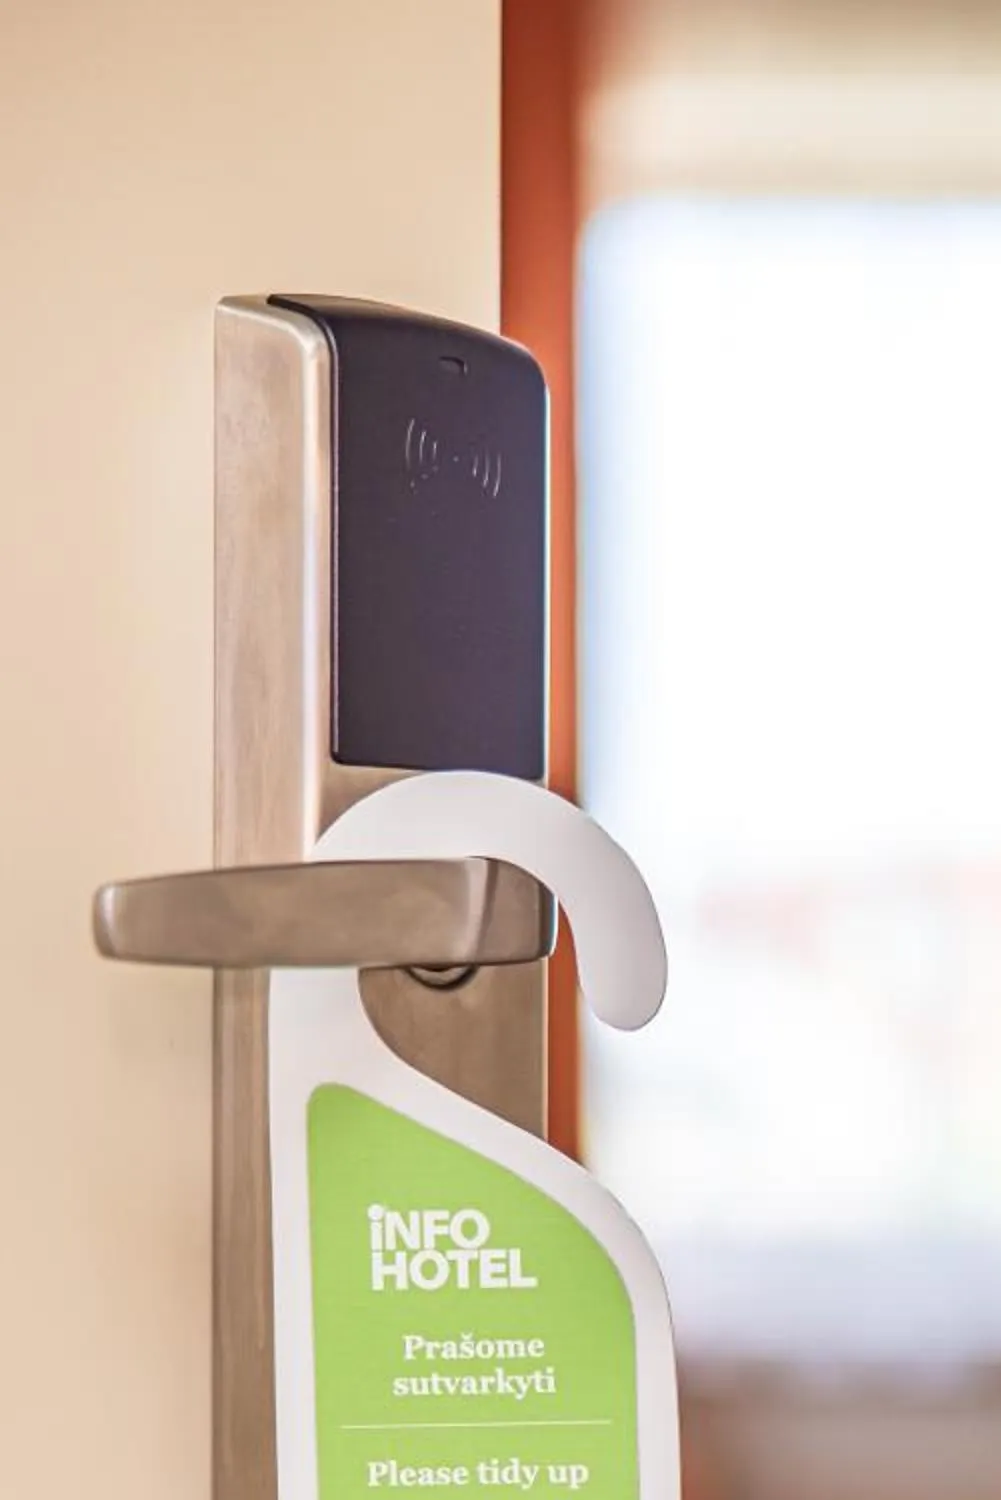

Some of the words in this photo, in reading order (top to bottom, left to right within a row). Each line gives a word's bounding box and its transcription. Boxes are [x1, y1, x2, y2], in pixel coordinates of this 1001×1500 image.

[371, 1248, 538, 1290] HOTEL
[403, 1332, 545, 1360] Prašome
[392, 1366, 556, 1400] sutvarkyti
[367, 1460, 469, 1487] Please
[476, 1457, 539, 1490] tidy
[548, 1463, 589, 1489] up
